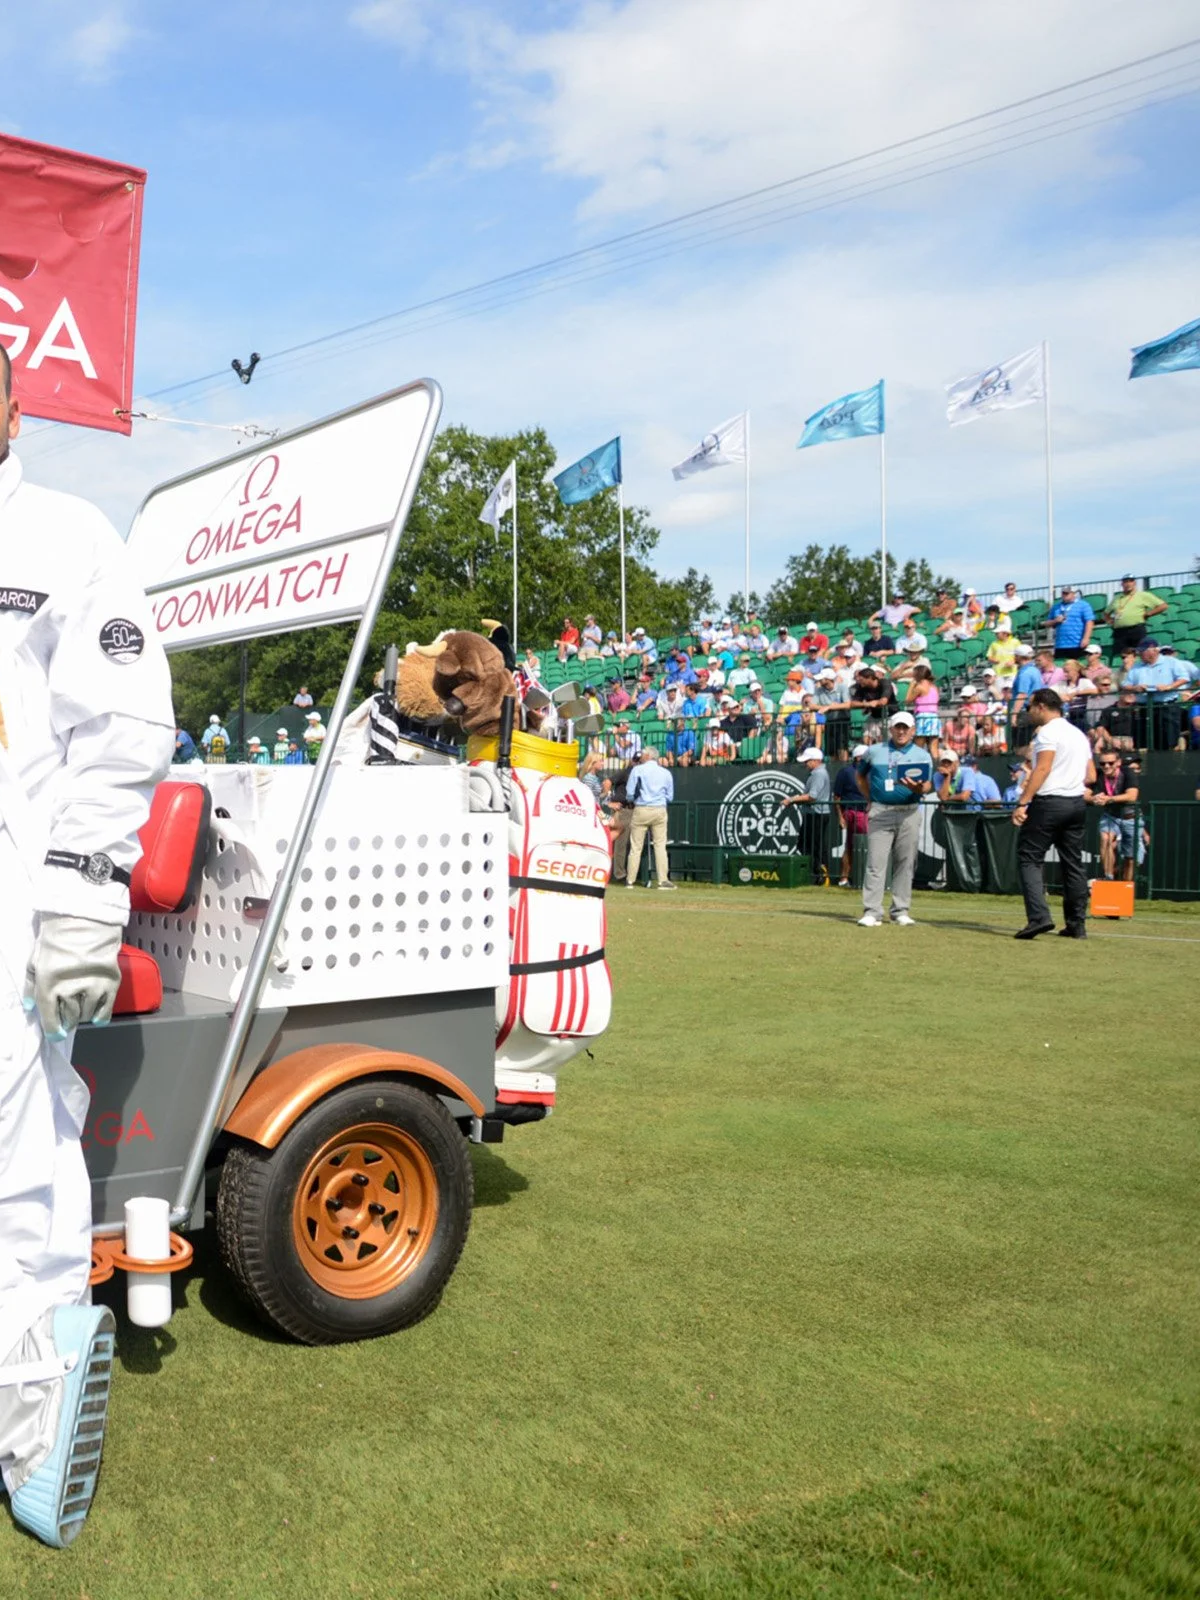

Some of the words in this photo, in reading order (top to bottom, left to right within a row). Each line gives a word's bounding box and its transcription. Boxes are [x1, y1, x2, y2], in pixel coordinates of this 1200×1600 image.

[185, 495, 302, 565] OMEGA
[152, 553, 349, 632] OONWATCH
[555, 804, 587, 817] adidas
[738, 816, 800, 836] PGA
[536, 858, 608, 883] SERGIO
[752, 870, 780, 881] PGA
